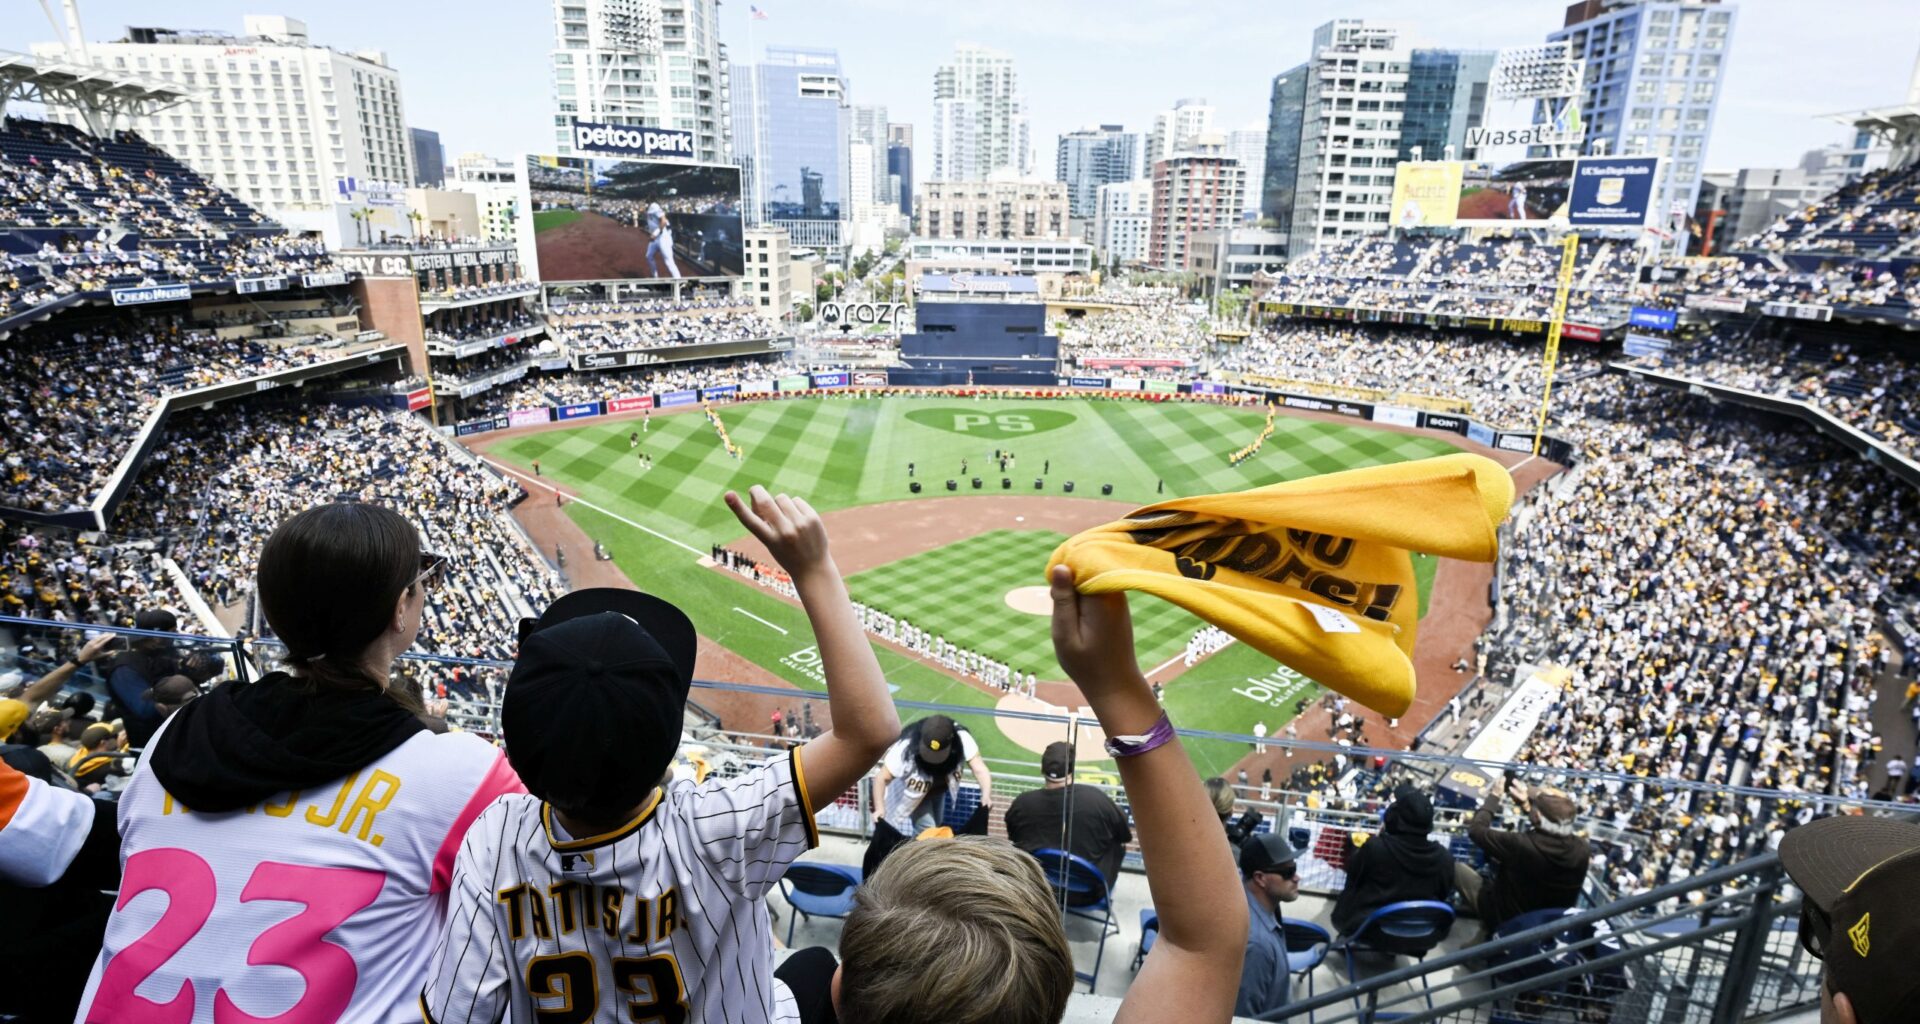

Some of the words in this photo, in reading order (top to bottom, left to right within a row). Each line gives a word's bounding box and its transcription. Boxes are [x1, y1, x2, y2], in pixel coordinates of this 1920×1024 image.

[576, 125, 642, 150] petco
[643, 132, 693, 154] park
[1470, 127, 1544, 147] Viasat
[381, 256, 412, 275] CO.
[413, 254, 452, 270] WESTERN
[453, 252, 477, 267] METAL
[479, 251, 504, 265] SUPPLY
[1502, 319, 1542, 333] PADRES
[817, 375, 840, 386] ARCO
[953, 413, 1036, 432] PS
[1231, 665, 1303, 703] blue
[304, 768, 402, 848] JR.
[497, 881, 626, 941] TATIS
[84, 847, 387, 1024] 23
